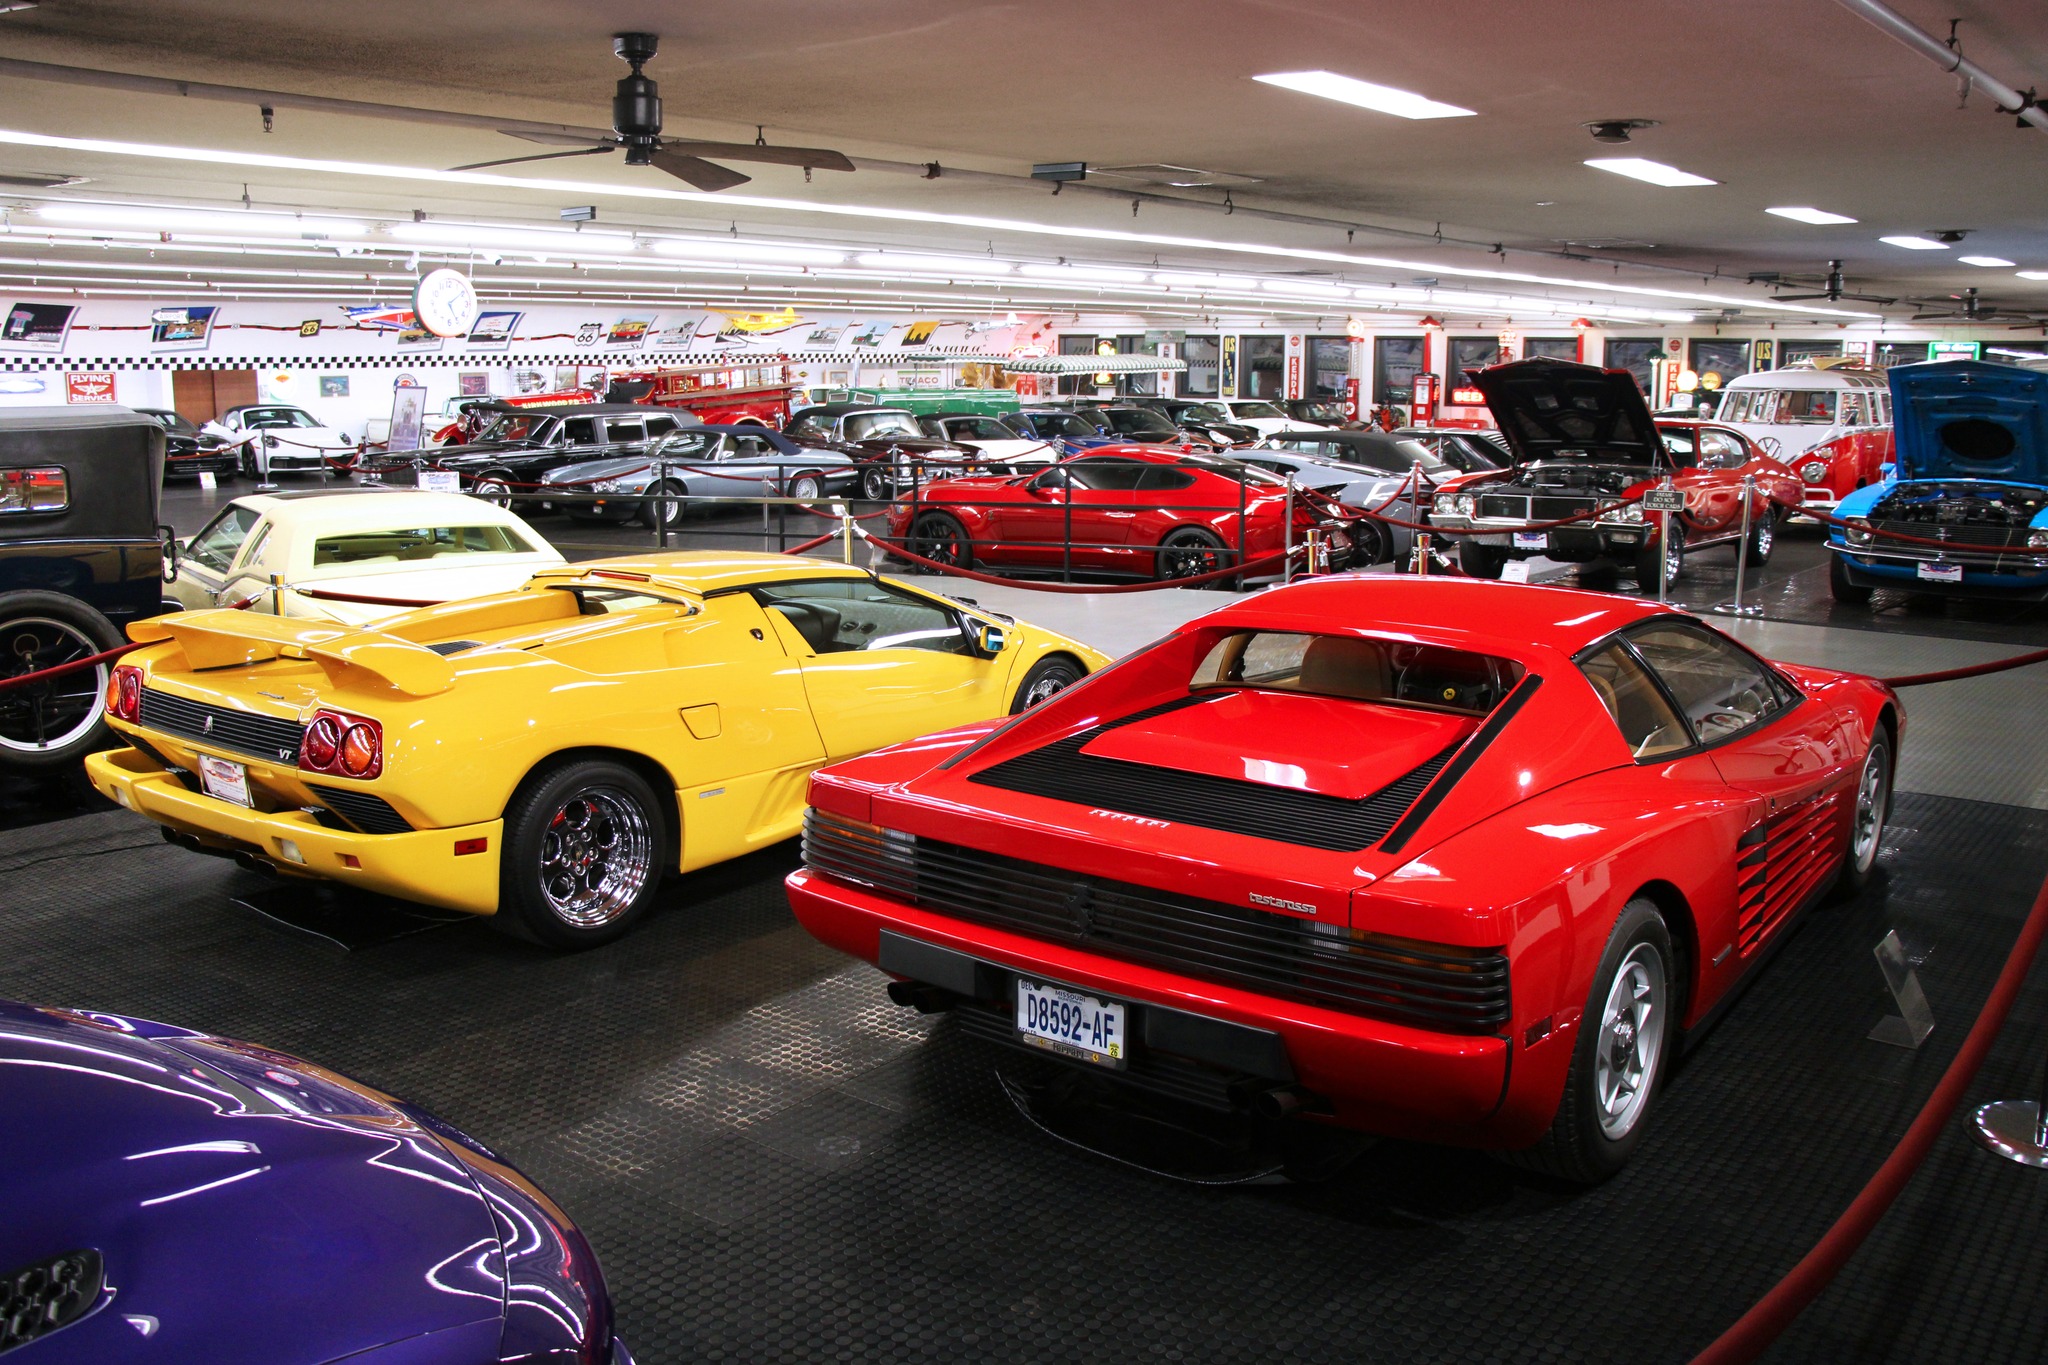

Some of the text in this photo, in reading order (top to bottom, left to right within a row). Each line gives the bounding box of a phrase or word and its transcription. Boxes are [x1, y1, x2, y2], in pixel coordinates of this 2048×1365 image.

[577, 332, 593, 342] 66
[1224, 352, 1234, 387] ROYAL
[70, 374, 111, 384] FLYING
[72, 393, 112, 401] SERVICE
[522, 400, 568, 409] KIRKWOOD
[279, 748, 293, 760] VT
[1249, 891, 1317, 915] testarossa
[1021, 980, 1033, 992] DEC
[1055, 990, 1086, 1003] MISSOURI
[1028, 993, 1115, 1049] D8592-AF
[1110, 1047, 1118, 1057] 26
